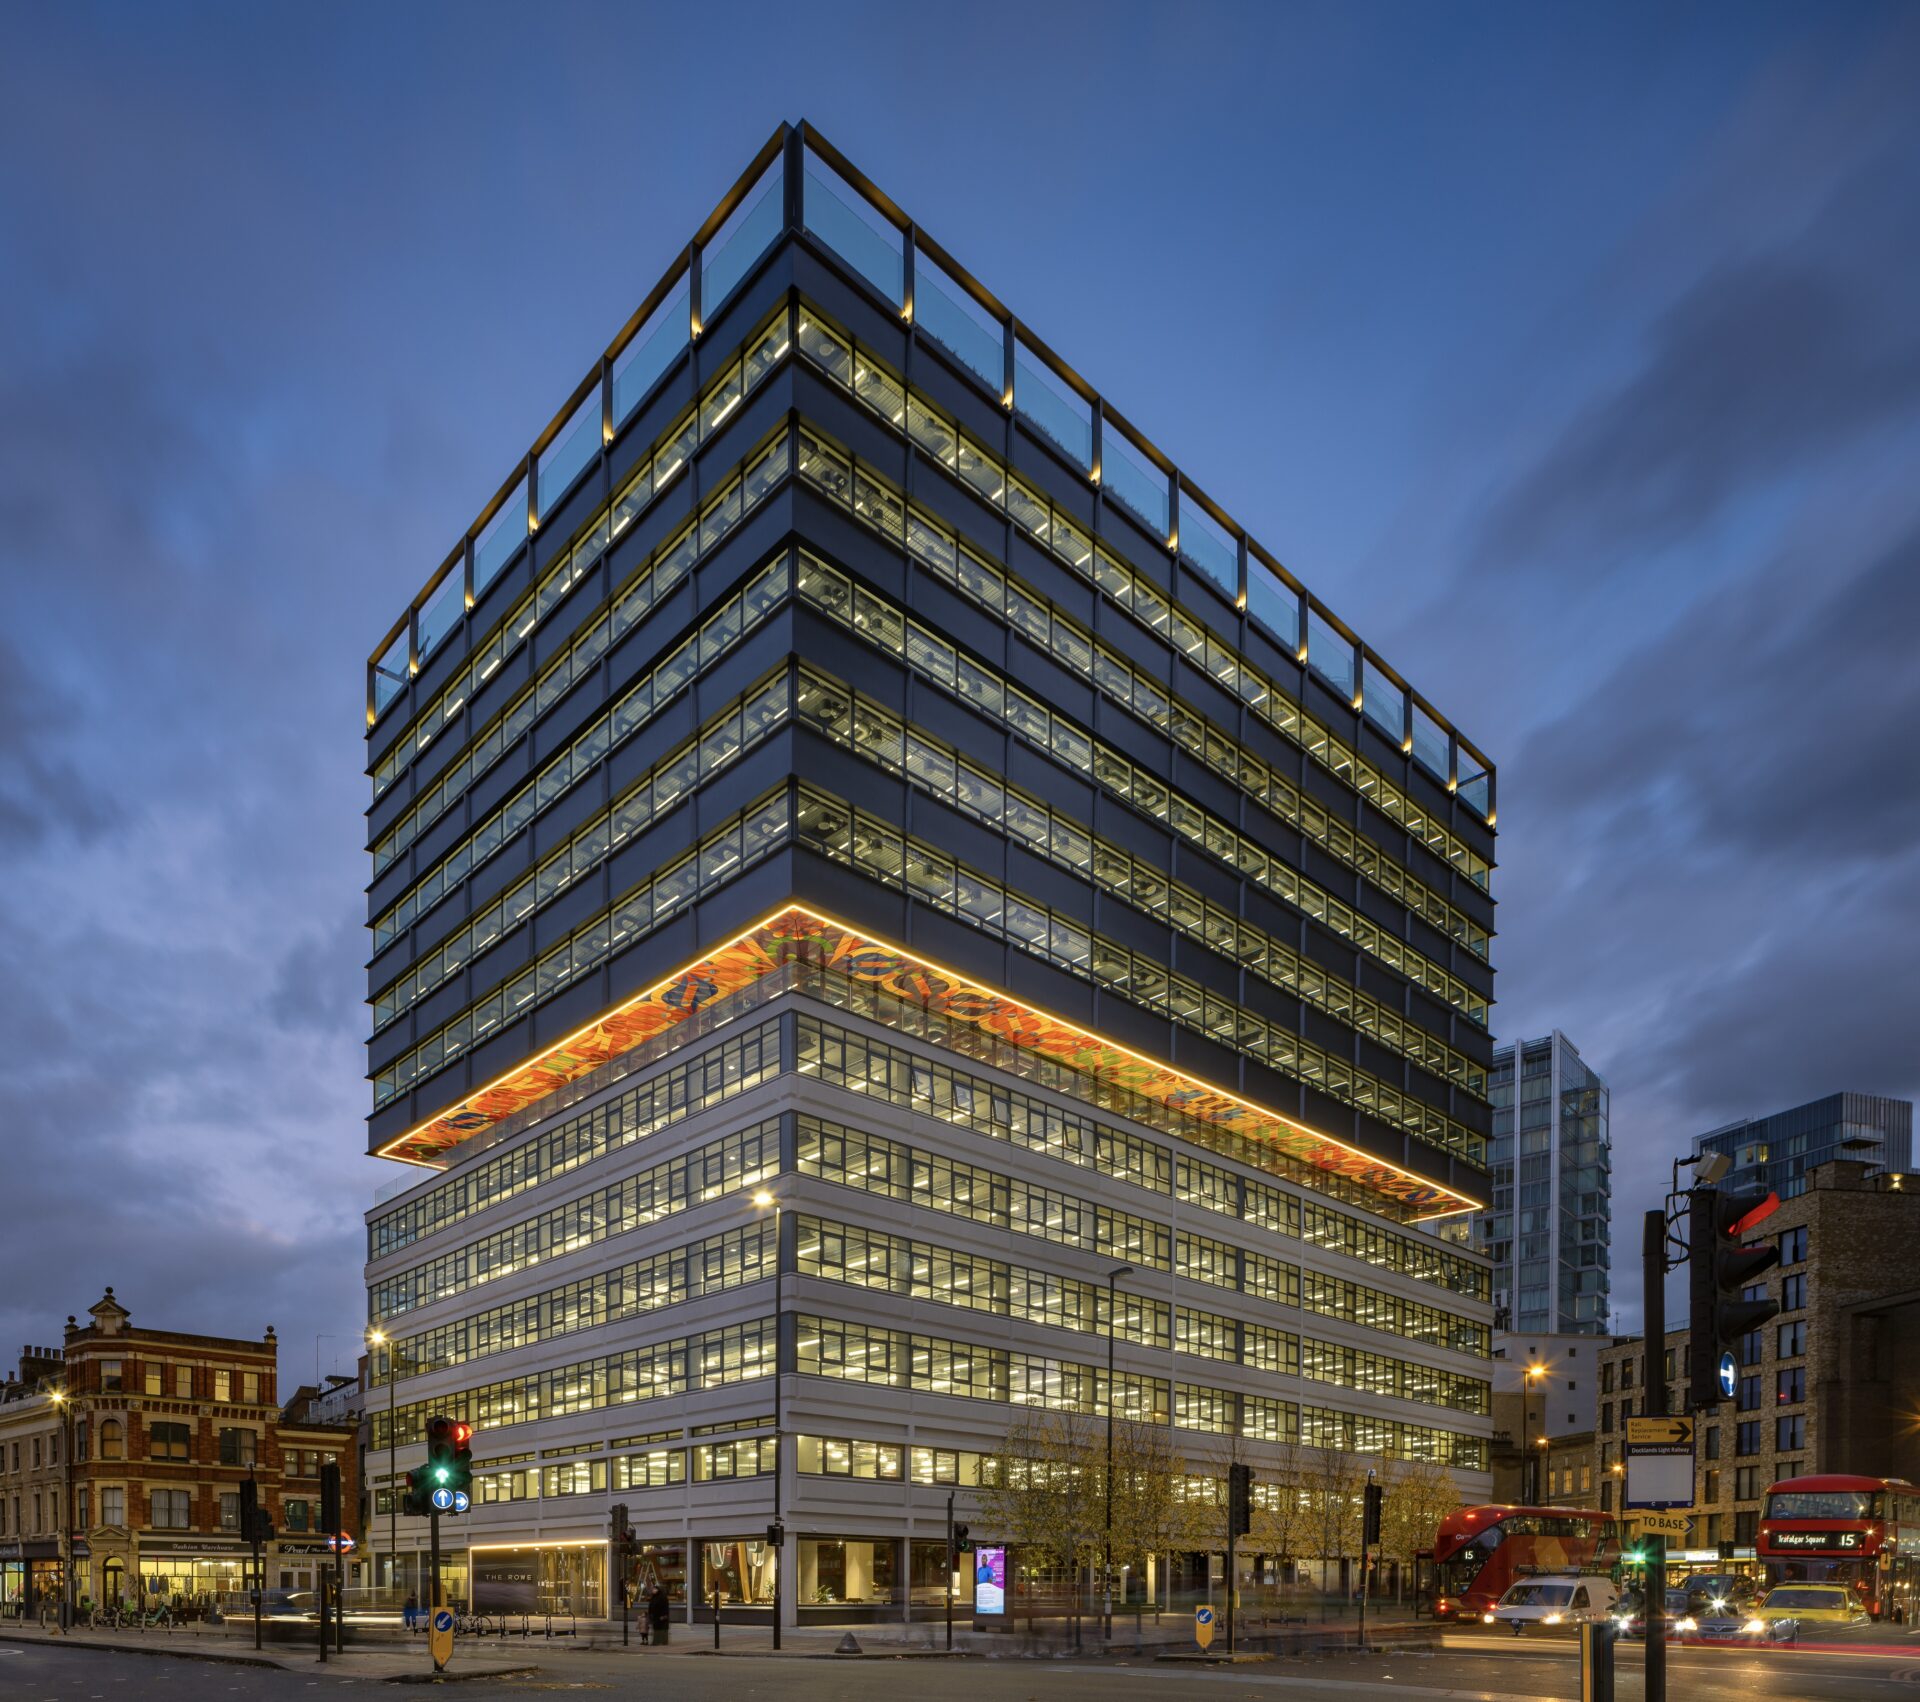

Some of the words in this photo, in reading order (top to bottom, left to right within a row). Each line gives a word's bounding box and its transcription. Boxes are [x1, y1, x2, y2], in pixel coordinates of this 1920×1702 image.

[1643, 1516, 1656, 1527] TO
[1658, 1518, 1684, 1530] BASE
[1778, 1535, 1804, 1544] Trafalgar
[1805, 1535, 1826, 1545] Square
[1841, 1534, 1855, 1546] 15
[284, 1544, 311, 1554] Pearl
[1464, 1550, 1474, 1560] 15
